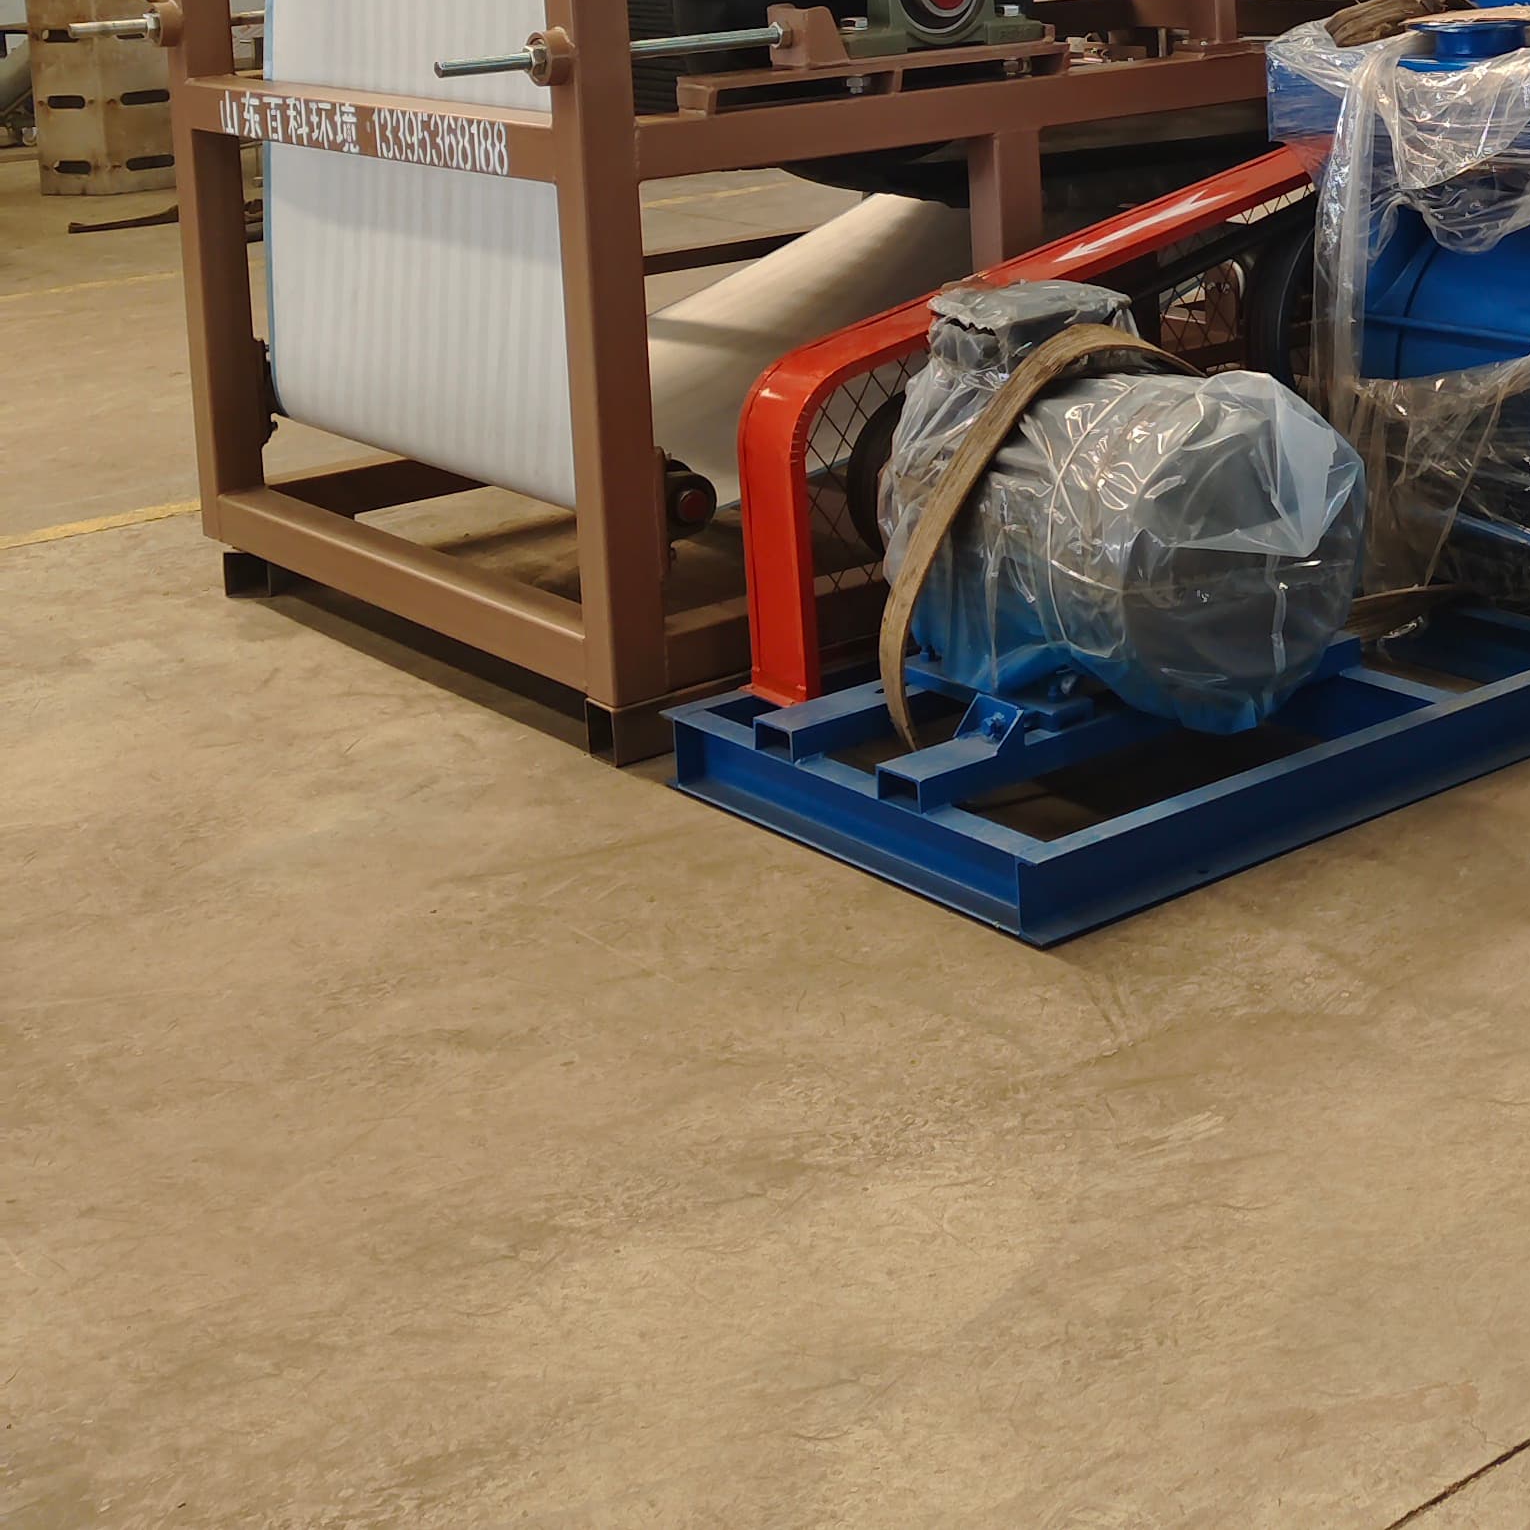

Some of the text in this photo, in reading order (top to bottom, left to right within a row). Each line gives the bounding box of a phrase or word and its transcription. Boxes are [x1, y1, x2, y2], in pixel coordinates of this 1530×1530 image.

[219, 89, 508, 175] 山东百科环境 13395368188
